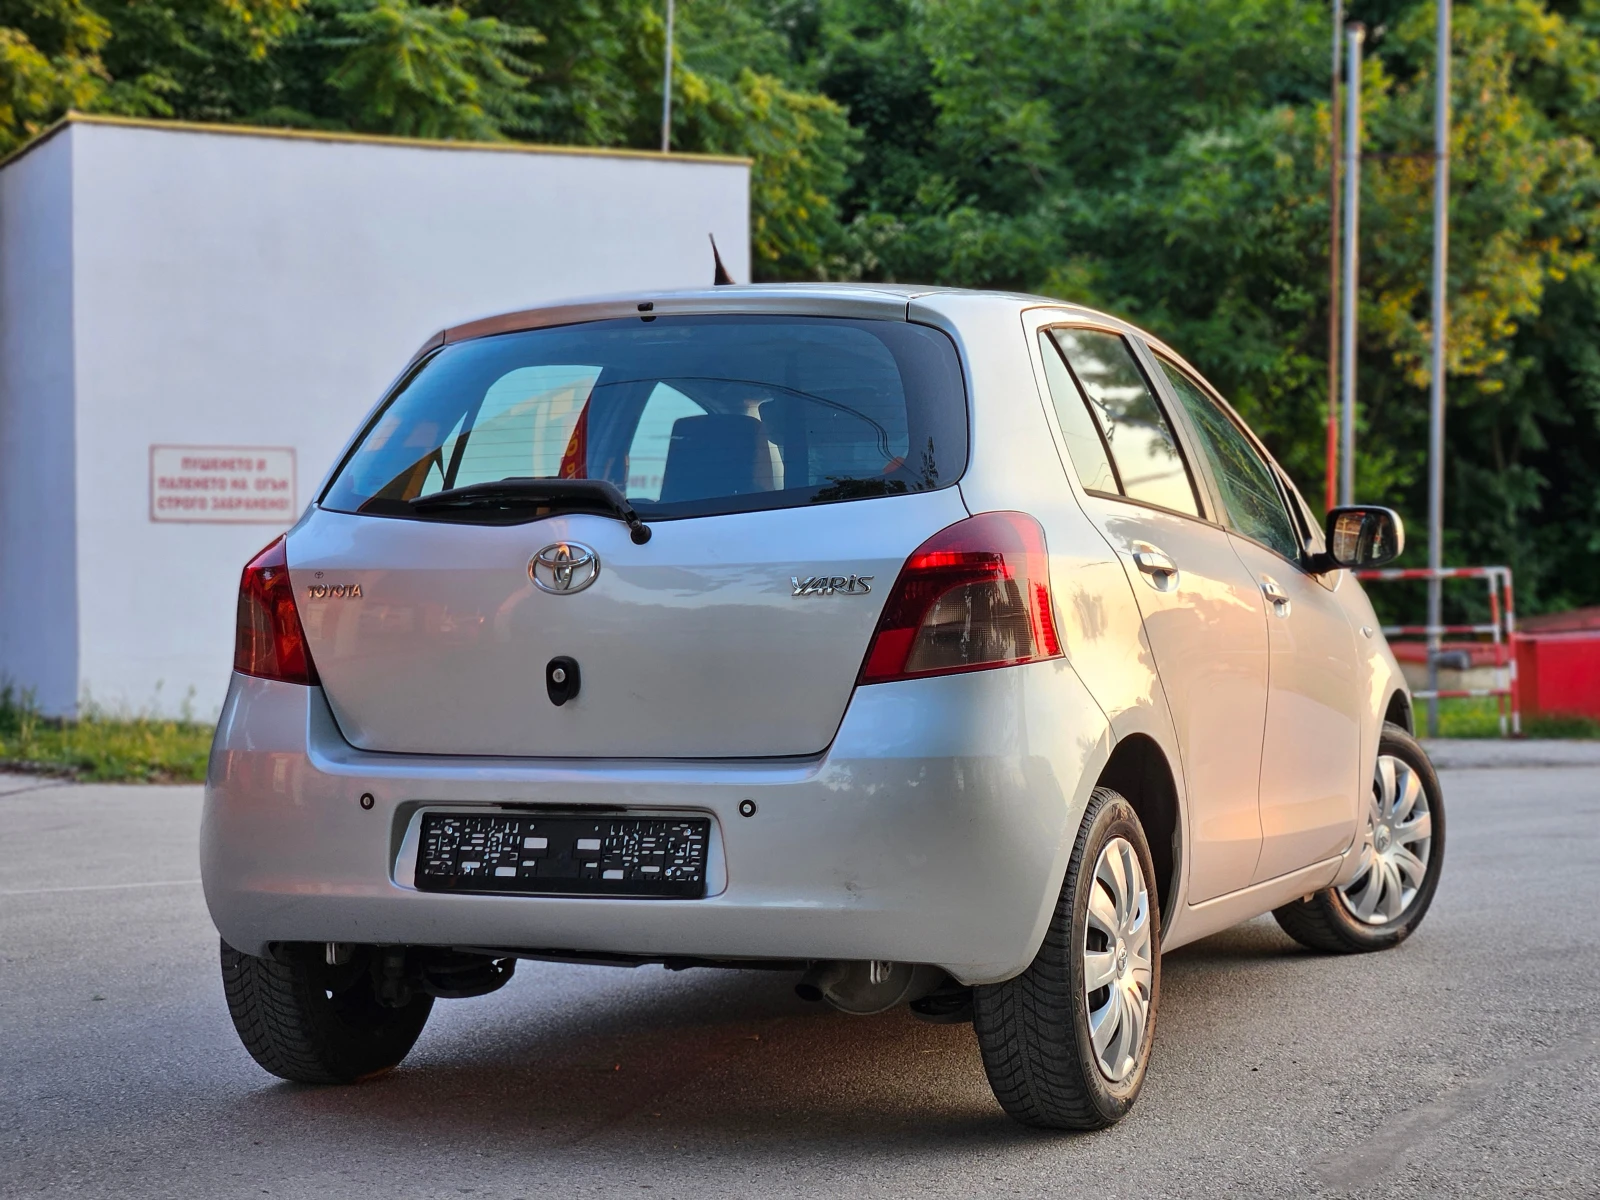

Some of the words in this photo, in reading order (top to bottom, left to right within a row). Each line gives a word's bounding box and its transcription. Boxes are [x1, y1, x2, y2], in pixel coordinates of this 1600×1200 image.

[230, 477, 247, 491] НА
[157, 496, 208, 511] СТРОГО
[307, 583, 363, 598] TOYOTA
